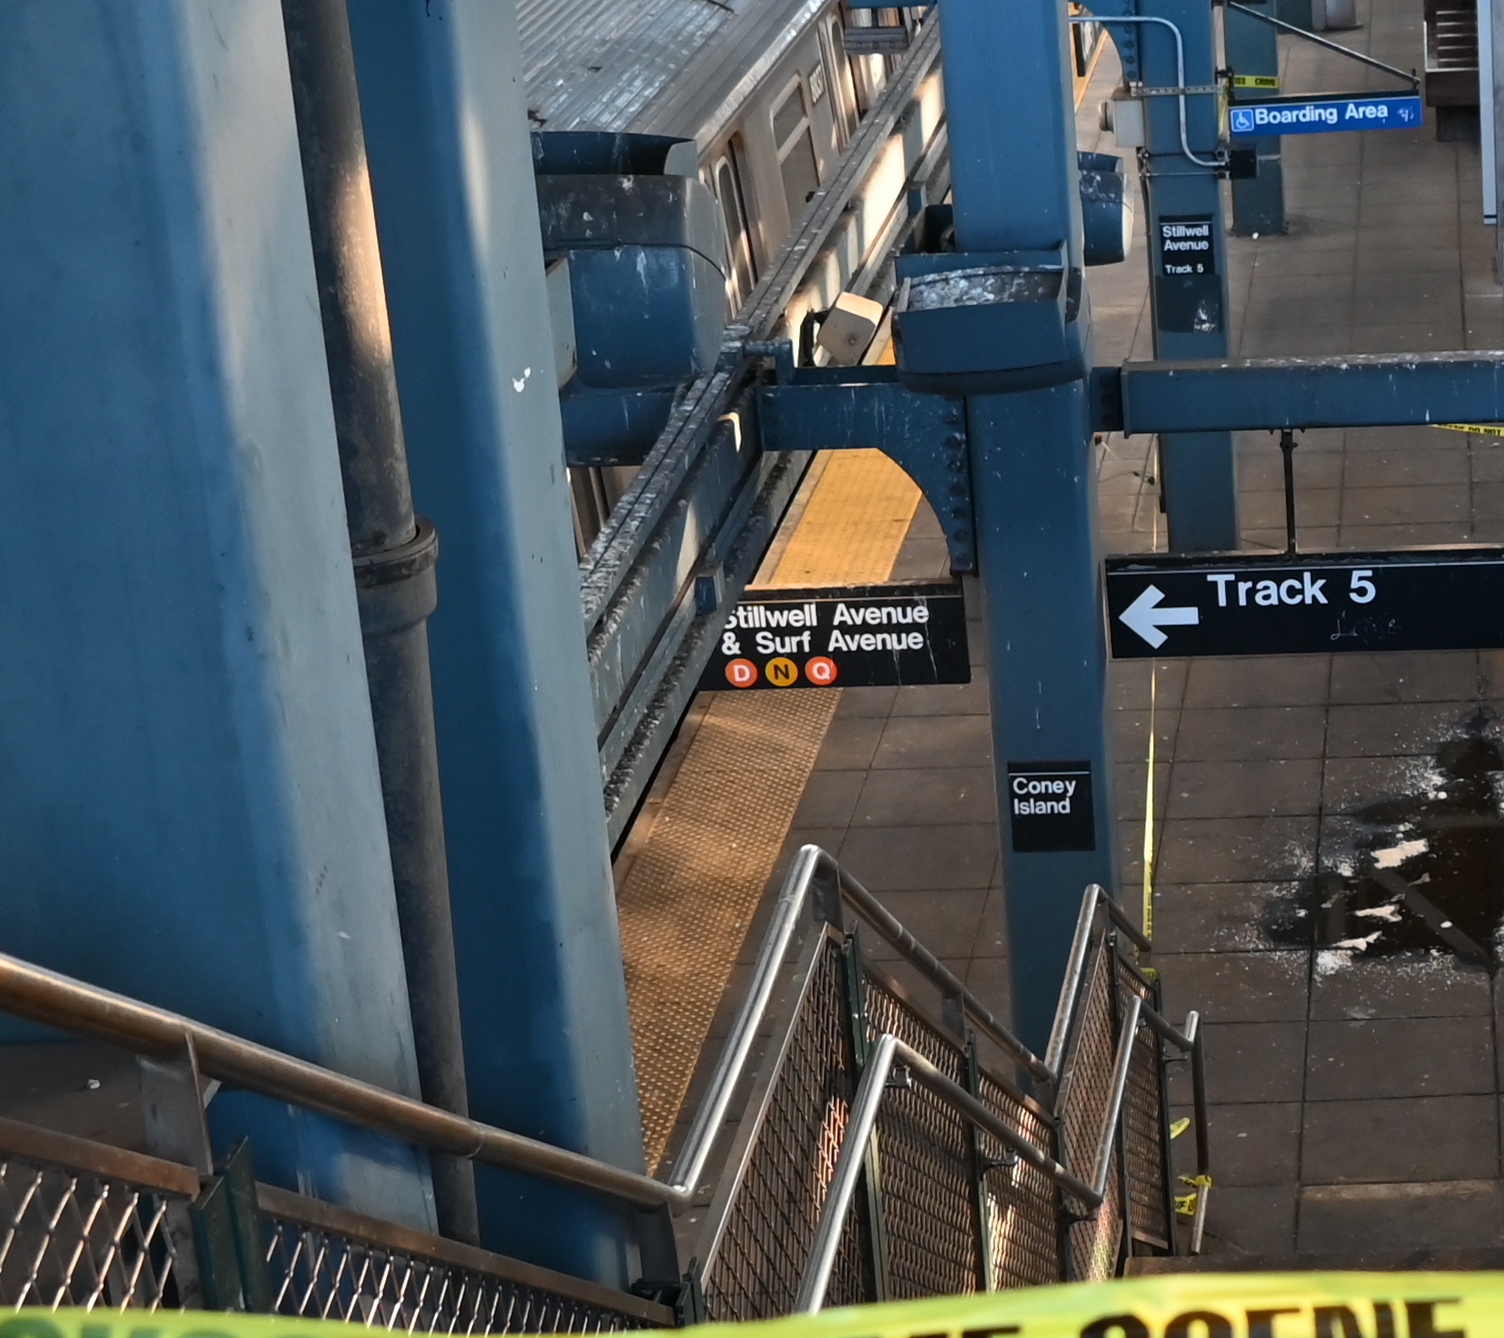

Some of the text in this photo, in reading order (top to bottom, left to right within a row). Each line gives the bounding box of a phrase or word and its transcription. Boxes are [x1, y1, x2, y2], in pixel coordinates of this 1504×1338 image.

[1255, 107, 1338, 126] Boarding
[1345, 103, 1388, 120] Area
[1162, 224, 1209, 238] Stillwell
[1163, 238, 1209, 251] Avenue
[1165, 263, 1204, 274] Track 5
[1206, 570, 1377, 607] Track 5
[832, 602, 929, 626] Avenue
[721, 629, 924, 655] & Surf Avenue
[733, 662, 831, 682] D N Q
[1013, 777, 1077, 797] Coney
[1014, 797, 1071, 815] Island
